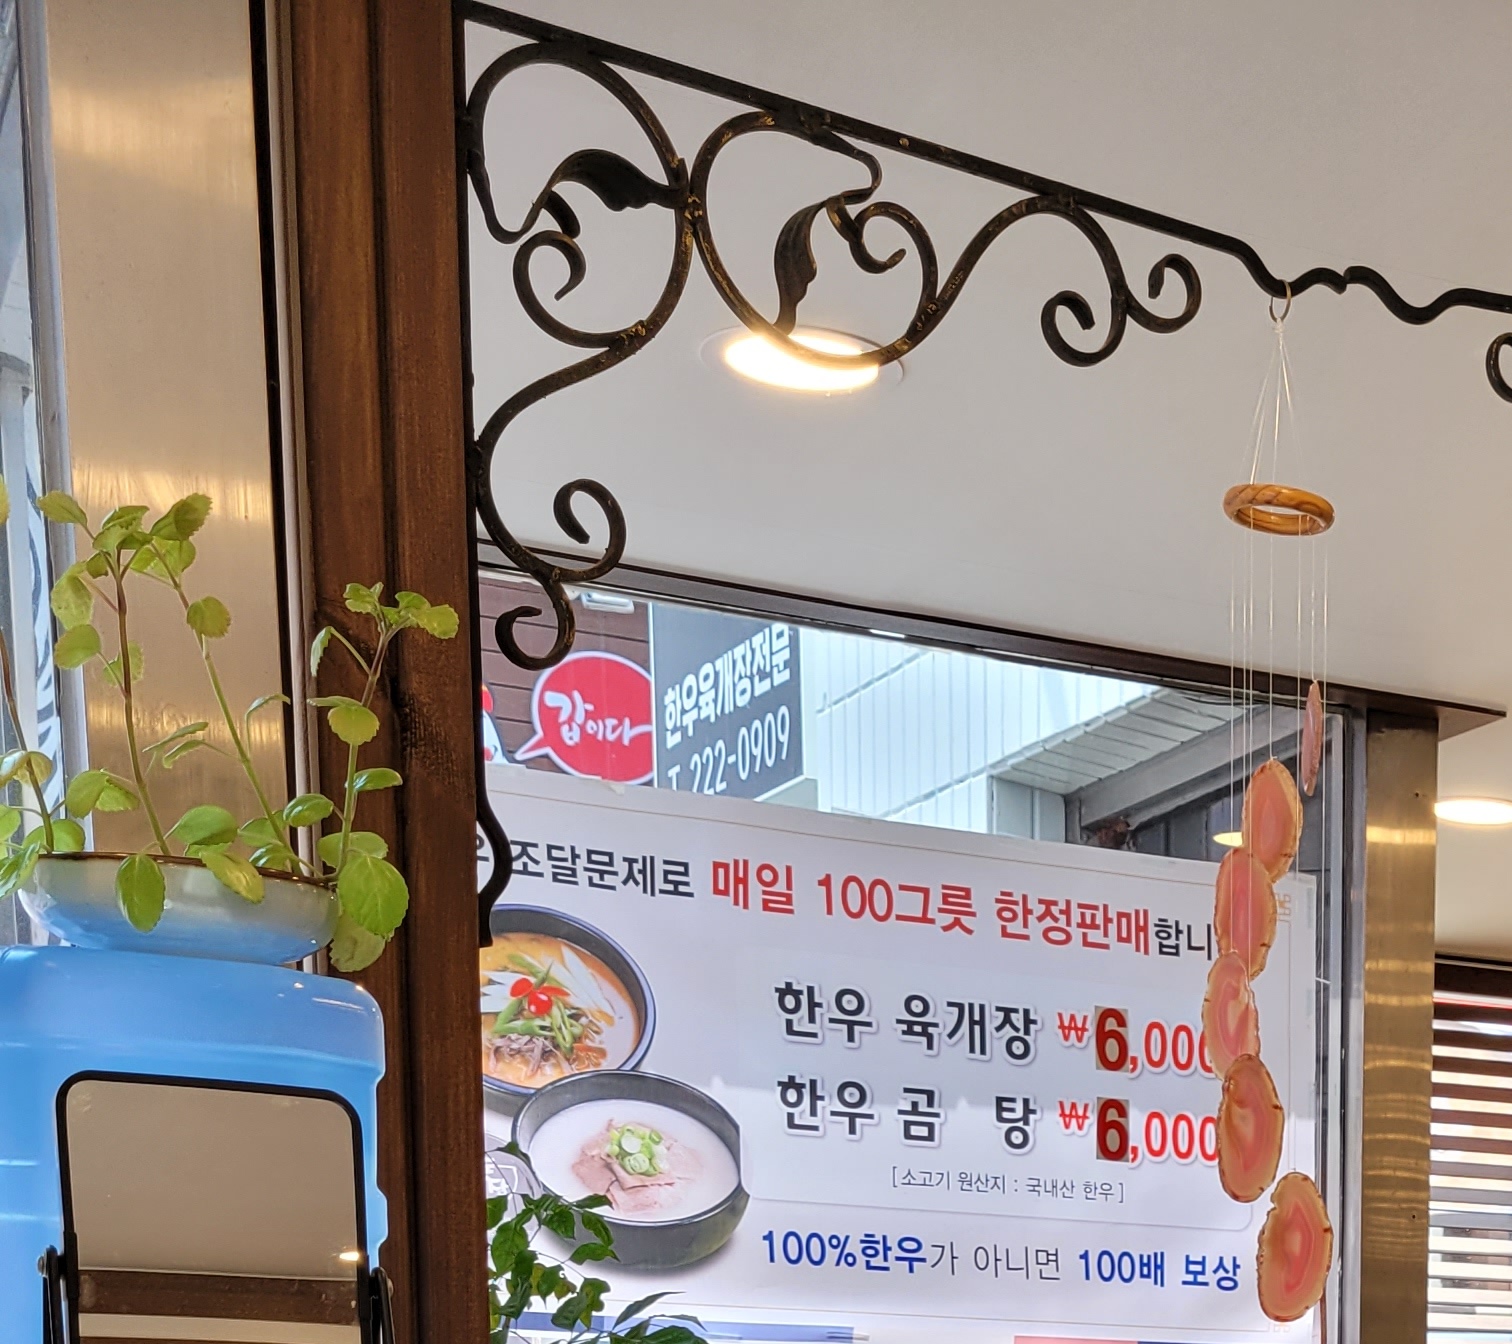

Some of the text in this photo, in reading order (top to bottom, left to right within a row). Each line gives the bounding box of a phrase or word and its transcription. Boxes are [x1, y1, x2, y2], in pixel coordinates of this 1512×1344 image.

[664, 623, 791, 750] 한우육개장전문
[690, 705, 790, 795] 222-0909
[510, 838, 695, 898] 조달문제로
[712, 858, 795, 915] 매일
[817, 873, 978, 937] 100그릇
[994, 890, 1213, 961] 한정판매합니
[774, 981, 873, 1044] 한우
[896, 993, 1037, 1062] 육개장
[777, 1074, 875, 1137] 한우
[897, 1086, 942, 1142] 곰
[995, 1094, 1037, 1151] 탕
[957, 1170, 1007, 1197] 원산지
[1025, 1176, 1076, 1200] 국내산
[761, 1230, 1241, 1292] 100%한우가 아니면 100배 보상
